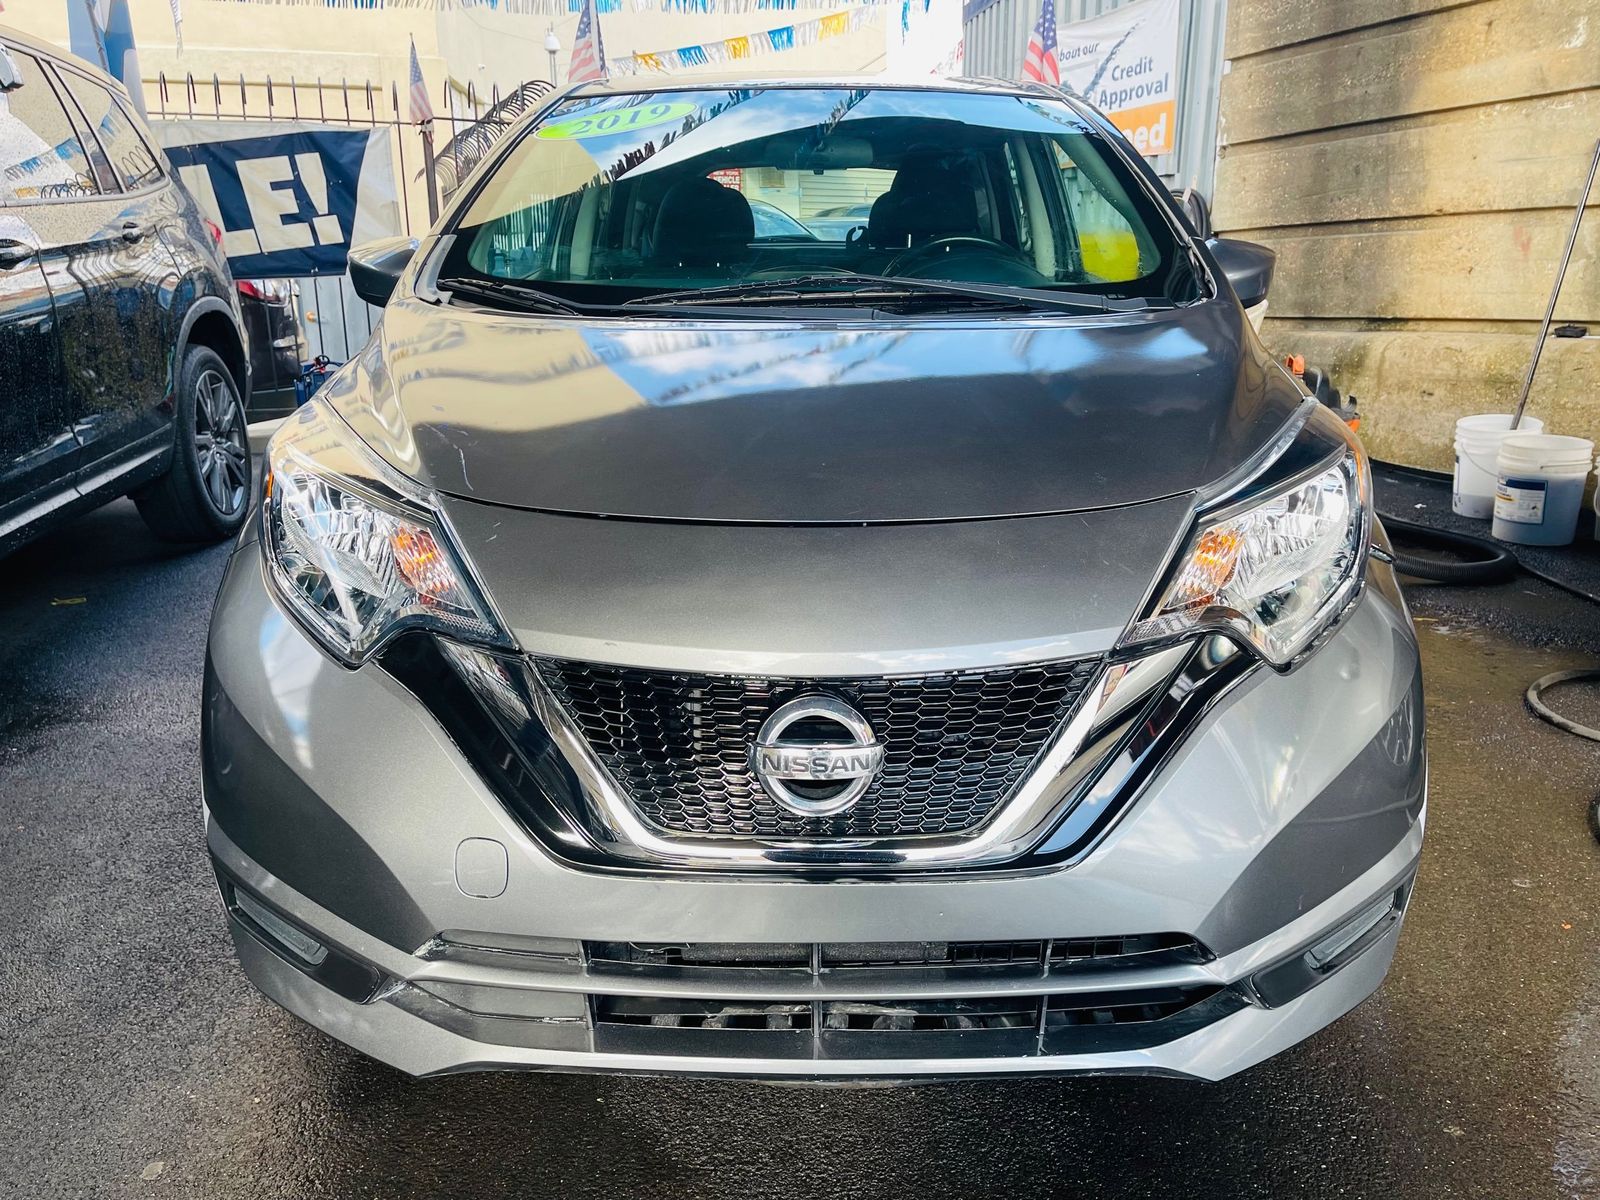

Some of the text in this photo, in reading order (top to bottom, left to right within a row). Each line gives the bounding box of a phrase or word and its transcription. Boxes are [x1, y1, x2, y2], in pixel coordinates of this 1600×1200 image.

[1058, 42, 1100, 62] bout our
[1112, 56, 1153, 82] Credit
[1098, 72, 1169, 110] Approval
[568, 104, 672, 136] 2019
[761, 753, 870, 773] NISSAN
